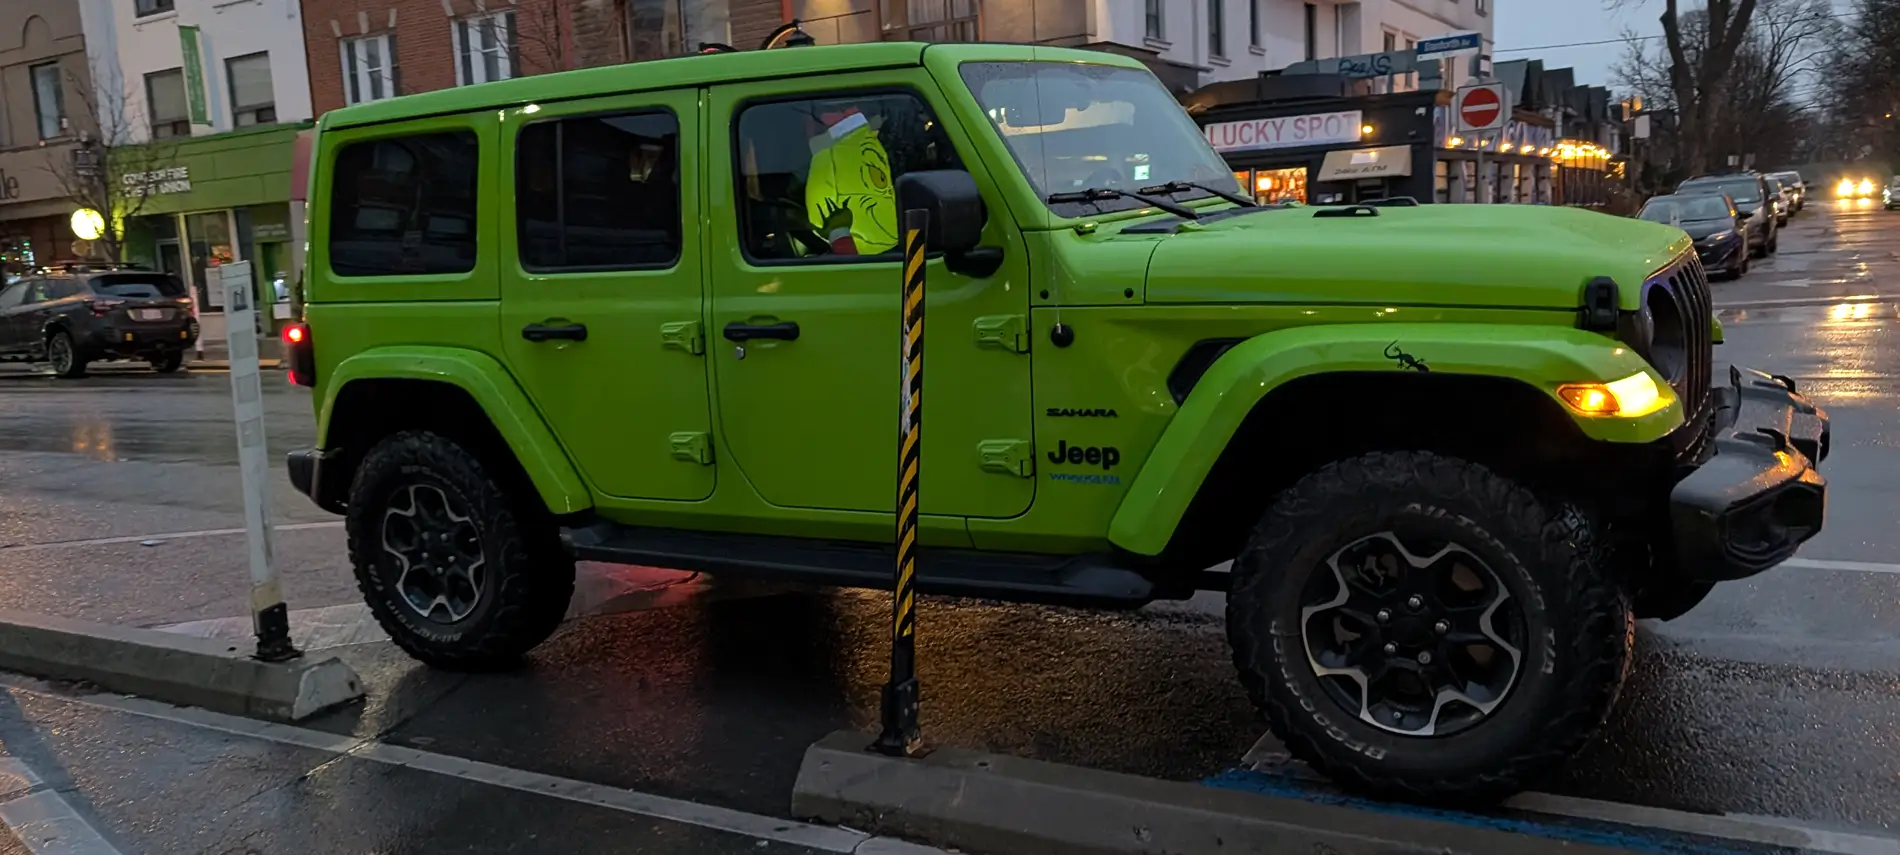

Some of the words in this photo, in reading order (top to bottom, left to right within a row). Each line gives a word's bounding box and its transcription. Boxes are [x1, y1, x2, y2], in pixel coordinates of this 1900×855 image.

[1208, 119, 1286, 147] LUCKY
[1293, 113, 1359, 141] SPOT
[1046, 408, 1118, 418] SAHARA
[1047, 439, 1120, 470] Jeep
